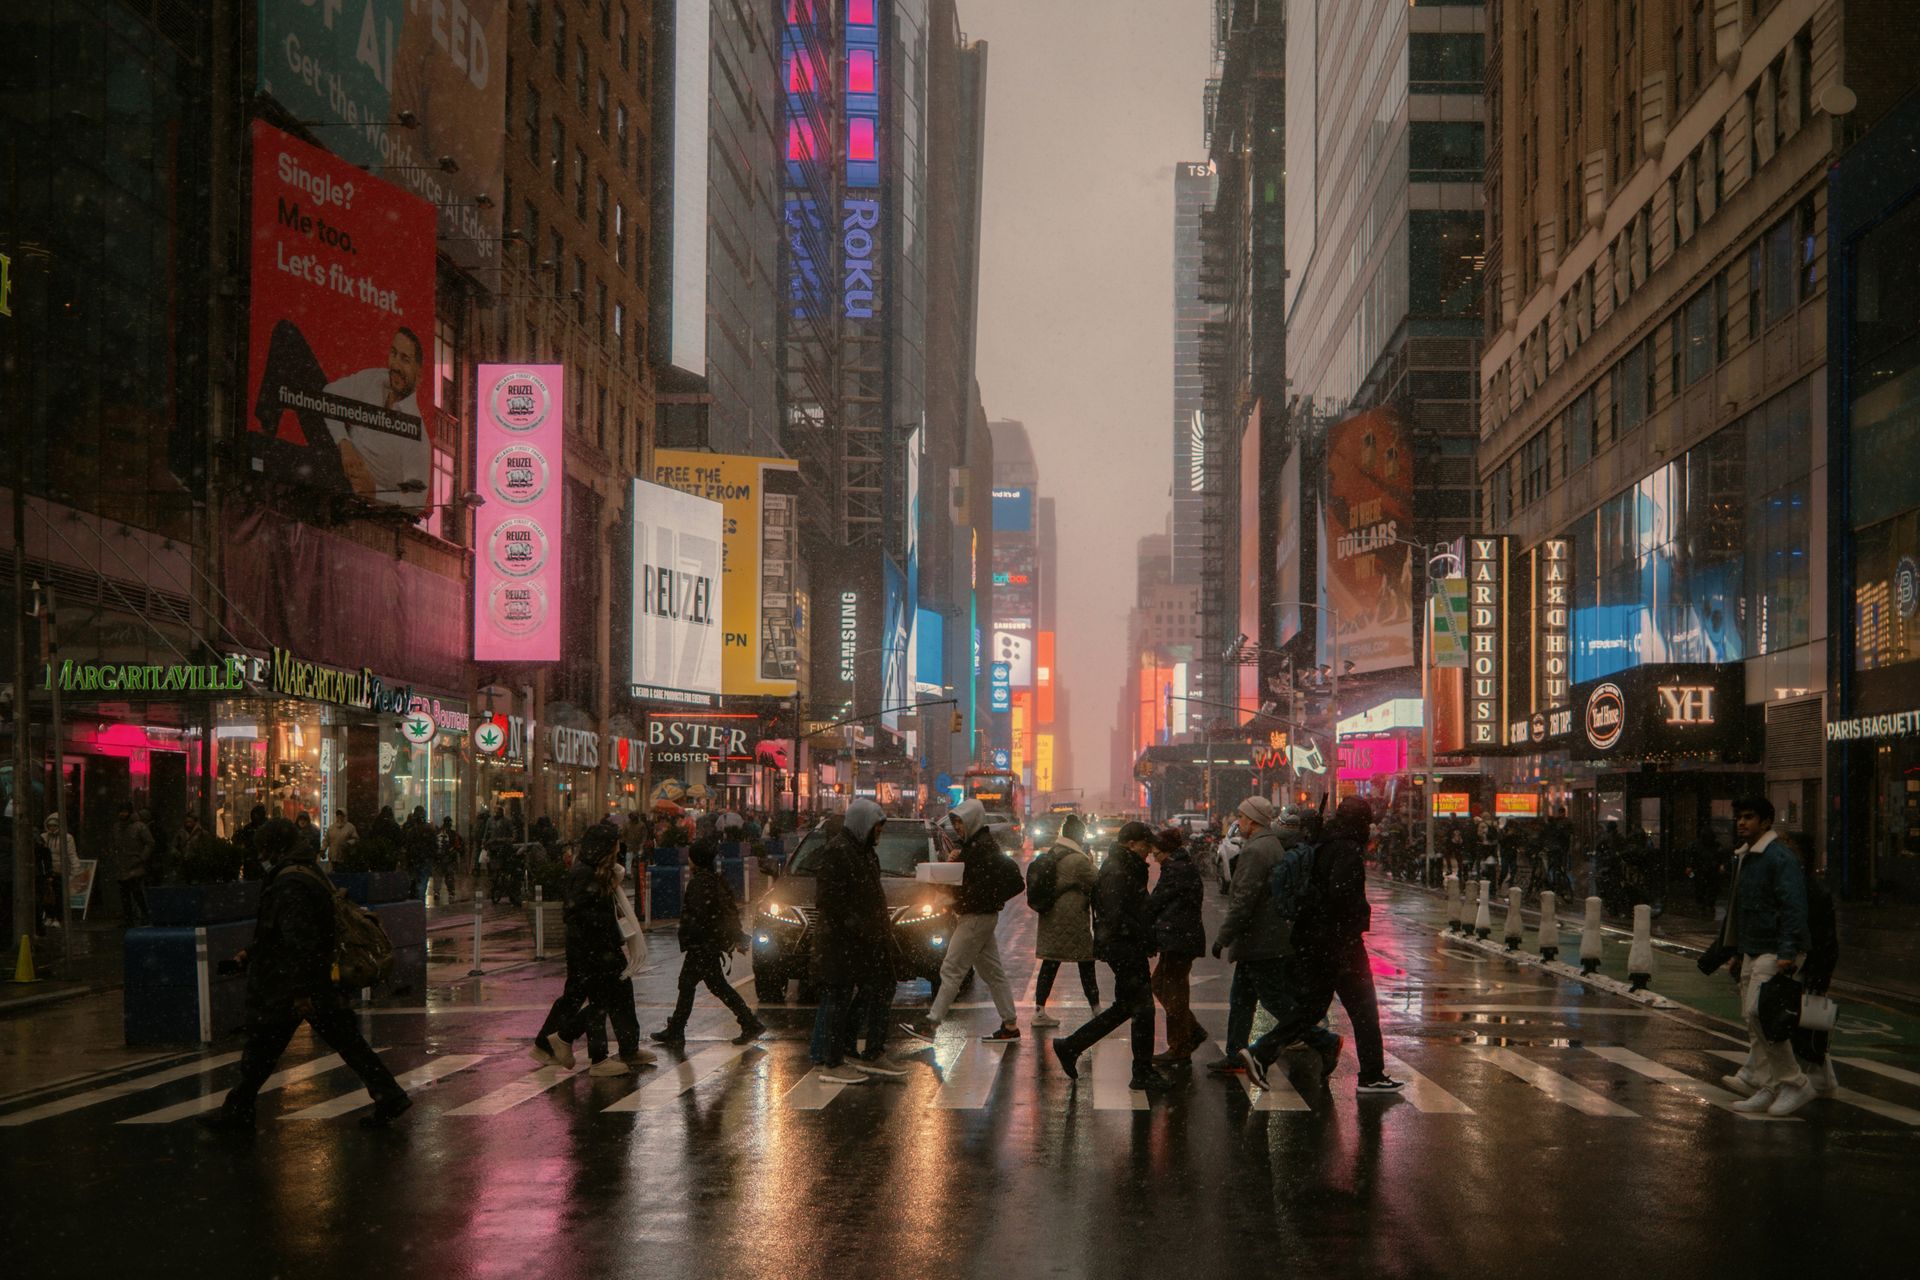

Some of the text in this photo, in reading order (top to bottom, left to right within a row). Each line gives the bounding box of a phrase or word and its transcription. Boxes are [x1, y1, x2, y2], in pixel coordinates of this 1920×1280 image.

[286, 33, 322, 97] Get
[328, 74, 358, 128] the
[364, 105, 442, 202] Workforce
[462, 206, 493, 257] Edge
[278, 152, 354, 209] Single?
[278, 197, 357, 254] Me too.
[844, 200, 880, 318] ROKU
[277, 241, 403, 315] Let's fix that.
[508, 385, 533, 395] REUZEL
[279, 386, 418, 436] findmohamedawife.com
[507, 458, 532, 467] REUZEL
[655, 466, 721, 483] FREE THE
[706, 482, 750, 500] FROM
[506, 531, 531, 541] REUZEL
[1337, 520, 1397, 560] DOLLARS
[505, 590, 530, 600] REUZEL
[645, 564, 714, 625] REUZEL
[841, 592, 856, 681] SAMSUNG
[994, 622, 1026, 630] SAMSUNG
[44, 658, 243, 690] MARGARITAVILLE
[273, 646, 373, 710] MARGARITAVILLE
[1658, 686, 1715, 723] YH
[552, 724, 600, 768] GIFTS
[650, 721, 747, 754] BSTER
[1827, 719, 1861, 741] PARIS
[628, 739, 647, 774] NY
